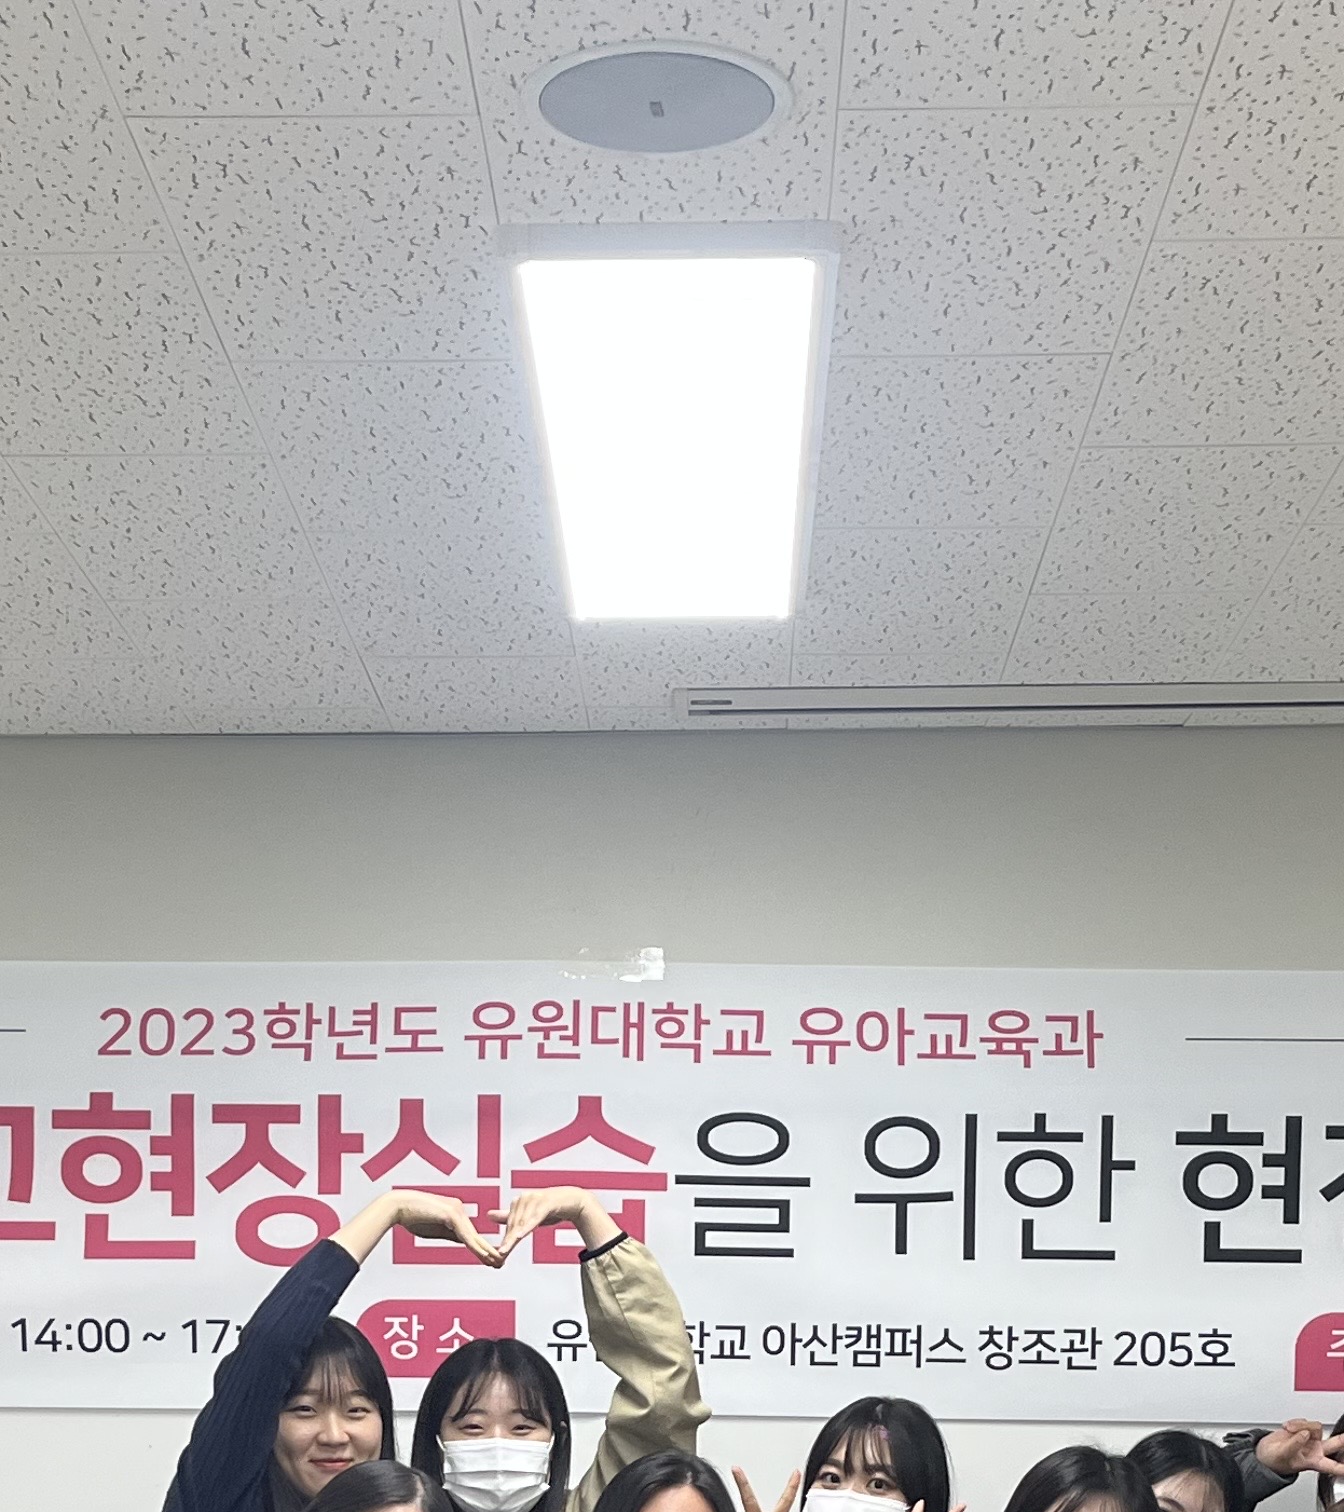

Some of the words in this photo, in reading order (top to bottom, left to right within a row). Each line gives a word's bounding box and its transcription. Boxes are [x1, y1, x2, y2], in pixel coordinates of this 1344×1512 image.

[97, 1001, 444, 1062] 2023학년도
[463, 999, 772, 1064] 유원대학교
[791, 1007, 1105, 1069] 유아교육과
[854, 1112, 1137, 1262] 위한
[10, 1317, 131, 1354] 14:00
[181, 1318, 243, 1354] 17:
[762, 1322, 967, 1369] 아산캠퍼스
[977, 1324, 1103, 1371] 창조관
[1112, 1327, 1236, 1368] 205호
